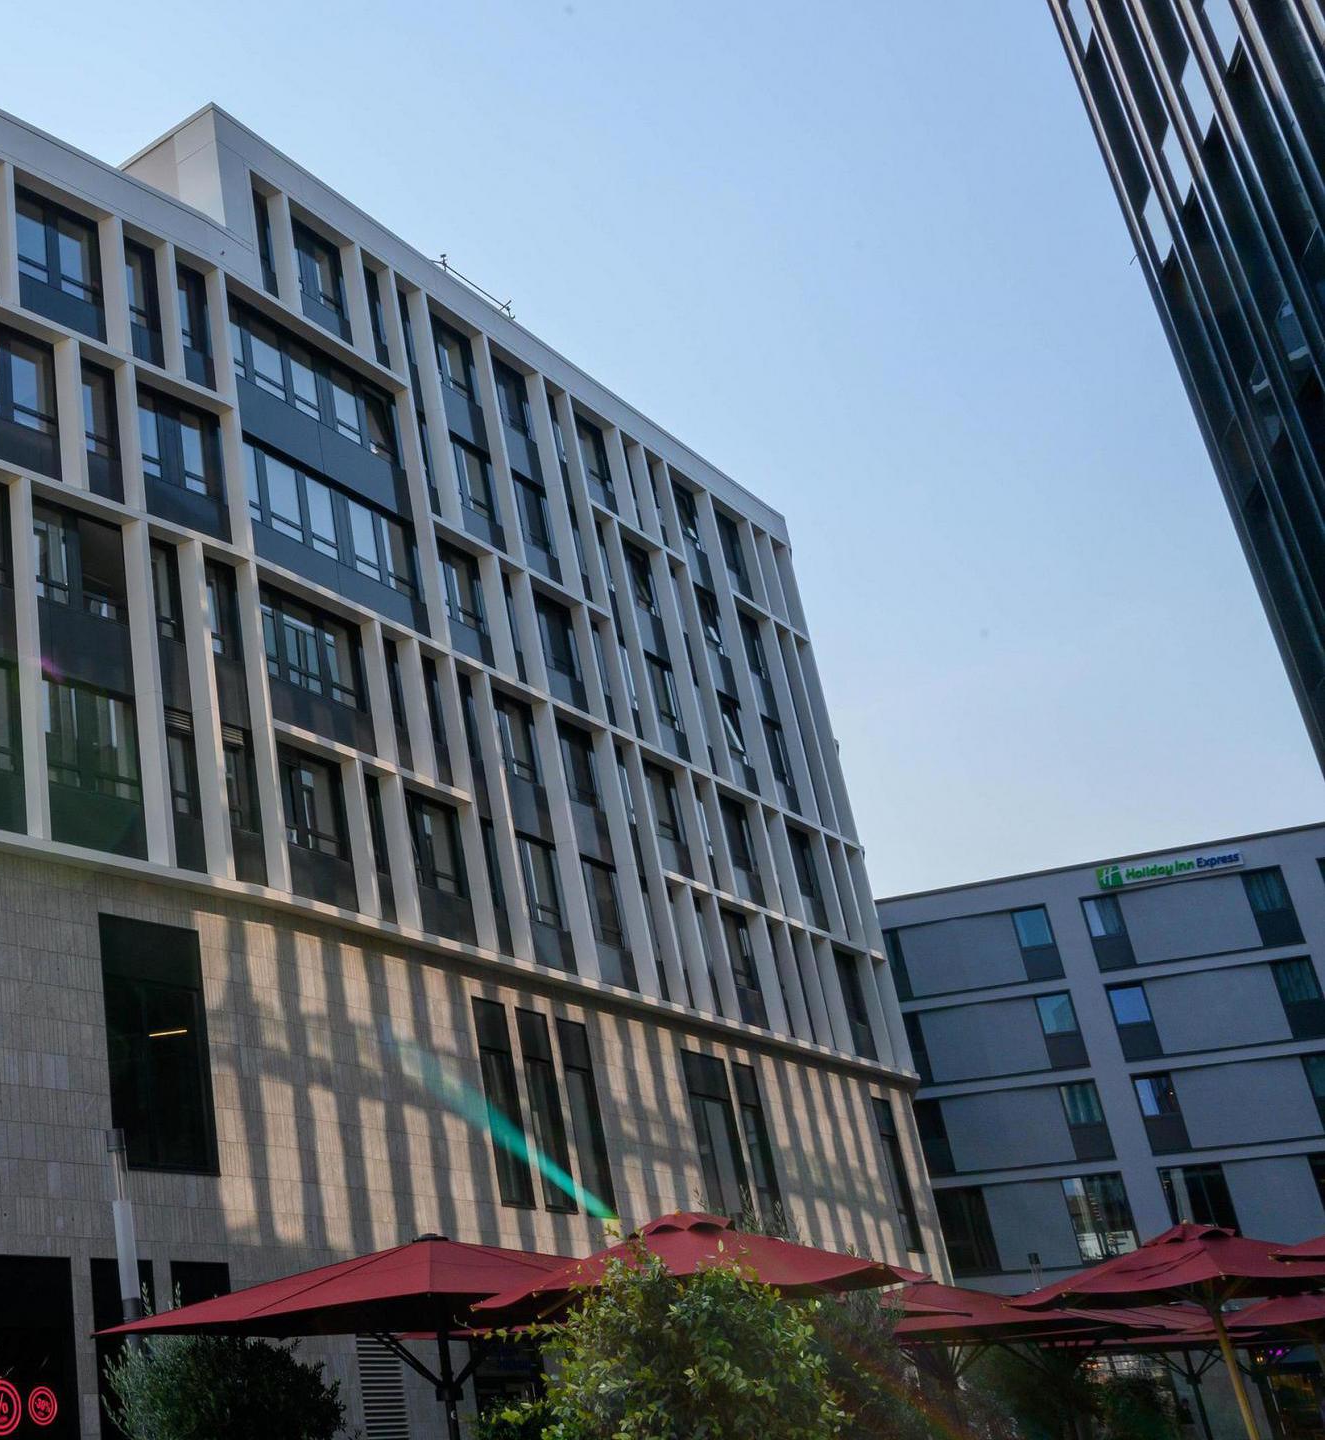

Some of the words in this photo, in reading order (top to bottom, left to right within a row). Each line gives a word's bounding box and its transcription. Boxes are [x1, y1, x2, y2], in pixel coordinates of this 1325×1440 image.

[1126, 863, 1173, 880] Holiday
[1175, 860, 1195, 873] Inn
[1196, 853, 1240, 868] Express
